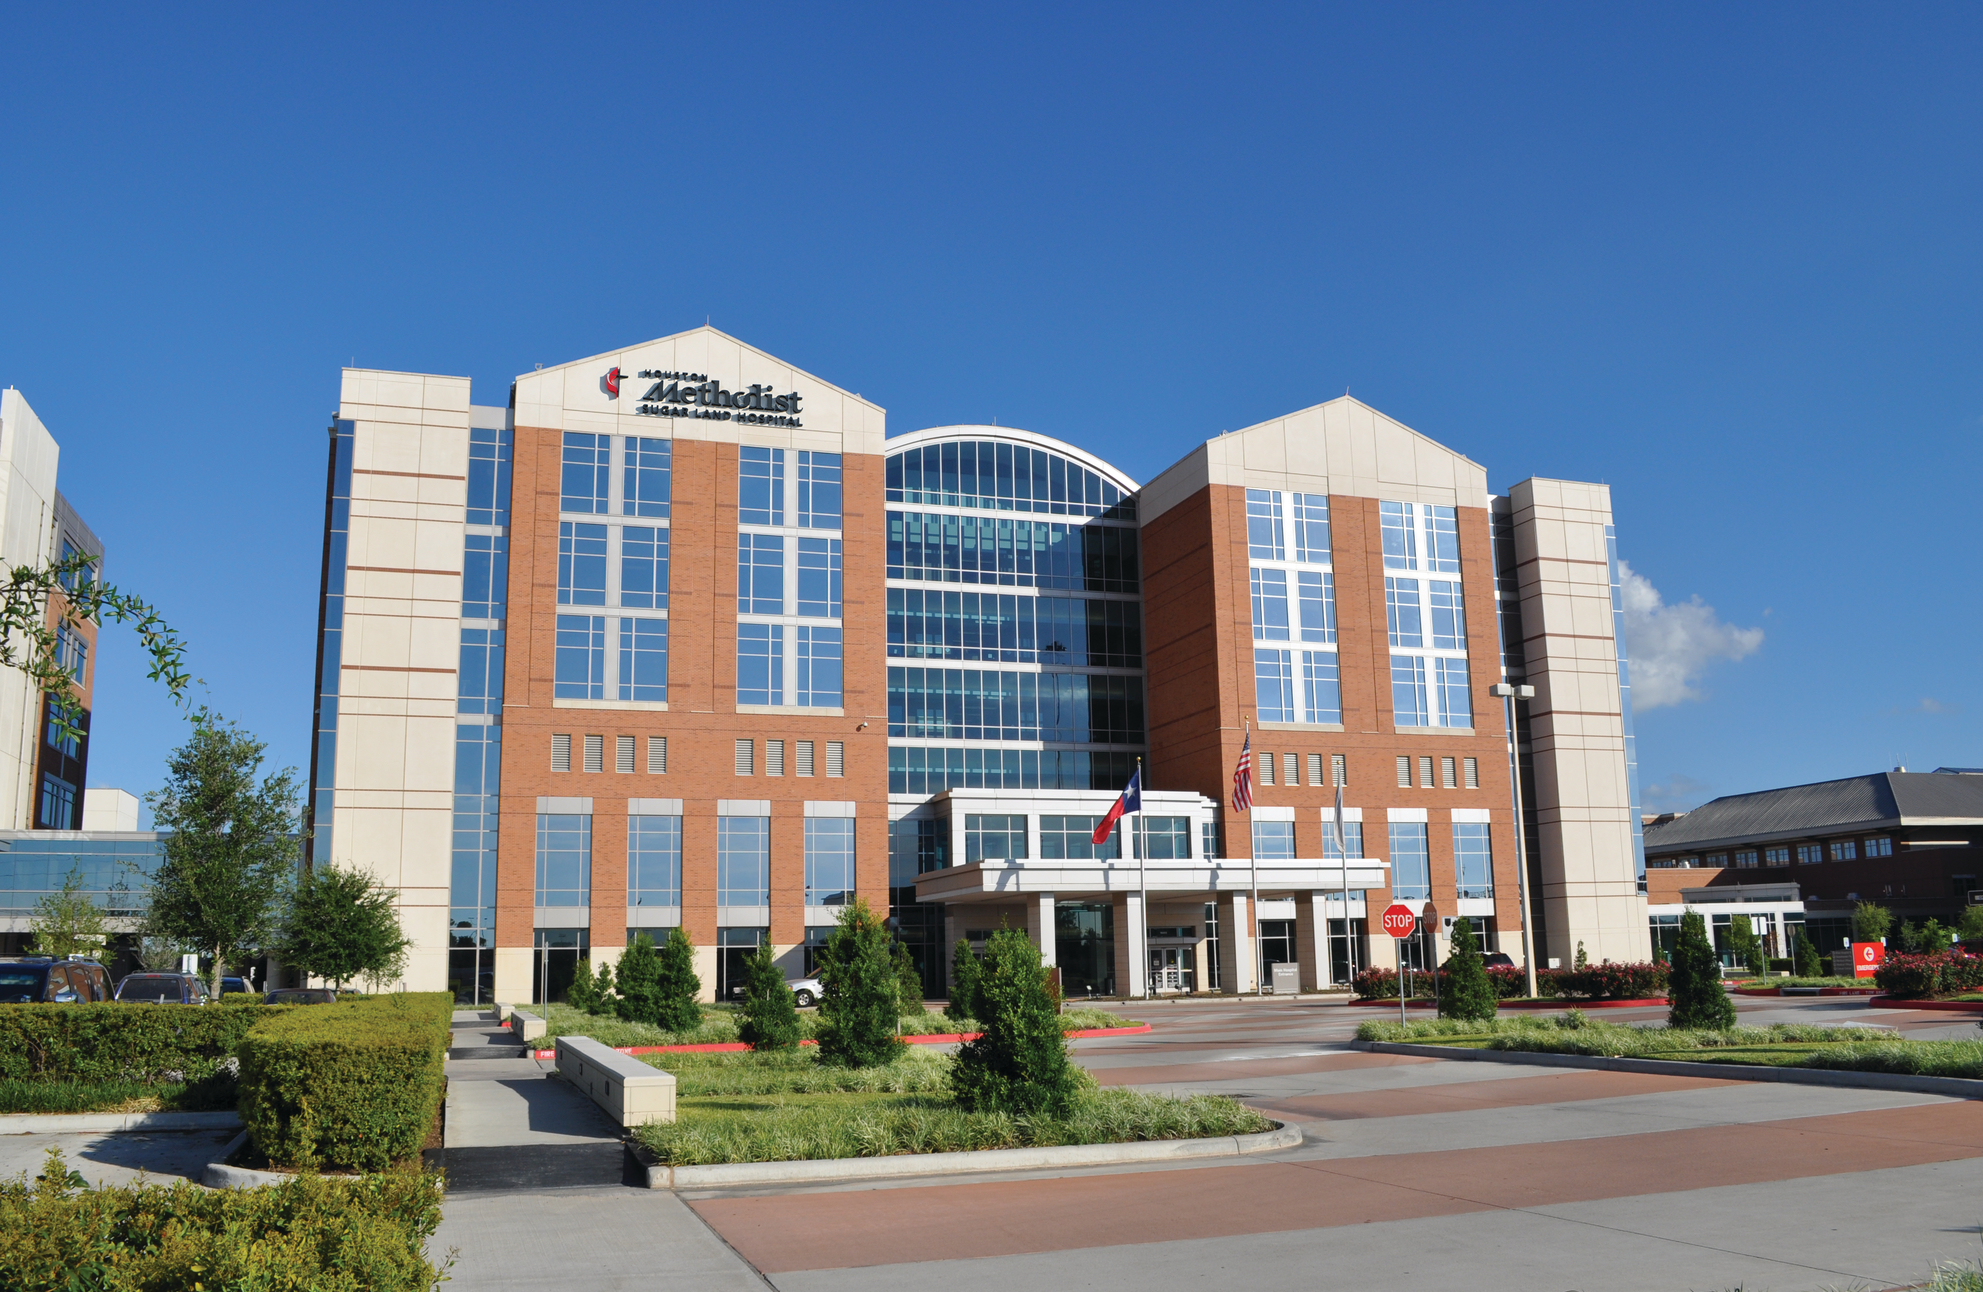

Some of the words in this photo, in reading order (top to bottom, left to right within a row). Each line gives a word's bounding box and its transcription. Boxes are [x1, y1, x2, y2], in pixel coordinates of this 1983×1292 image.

[644, 369, 708, 382] HOUSTON
[643, 380, 803, 414] Methodist
[643, 404, 689, 417] SUGAR
[695, 408, 731, 421] LAND
[737, 412, 803, 427] HOSPITAL
[1384, 915, 1412, 928] STOP
[1423, 912, 1437, 924] STOP
